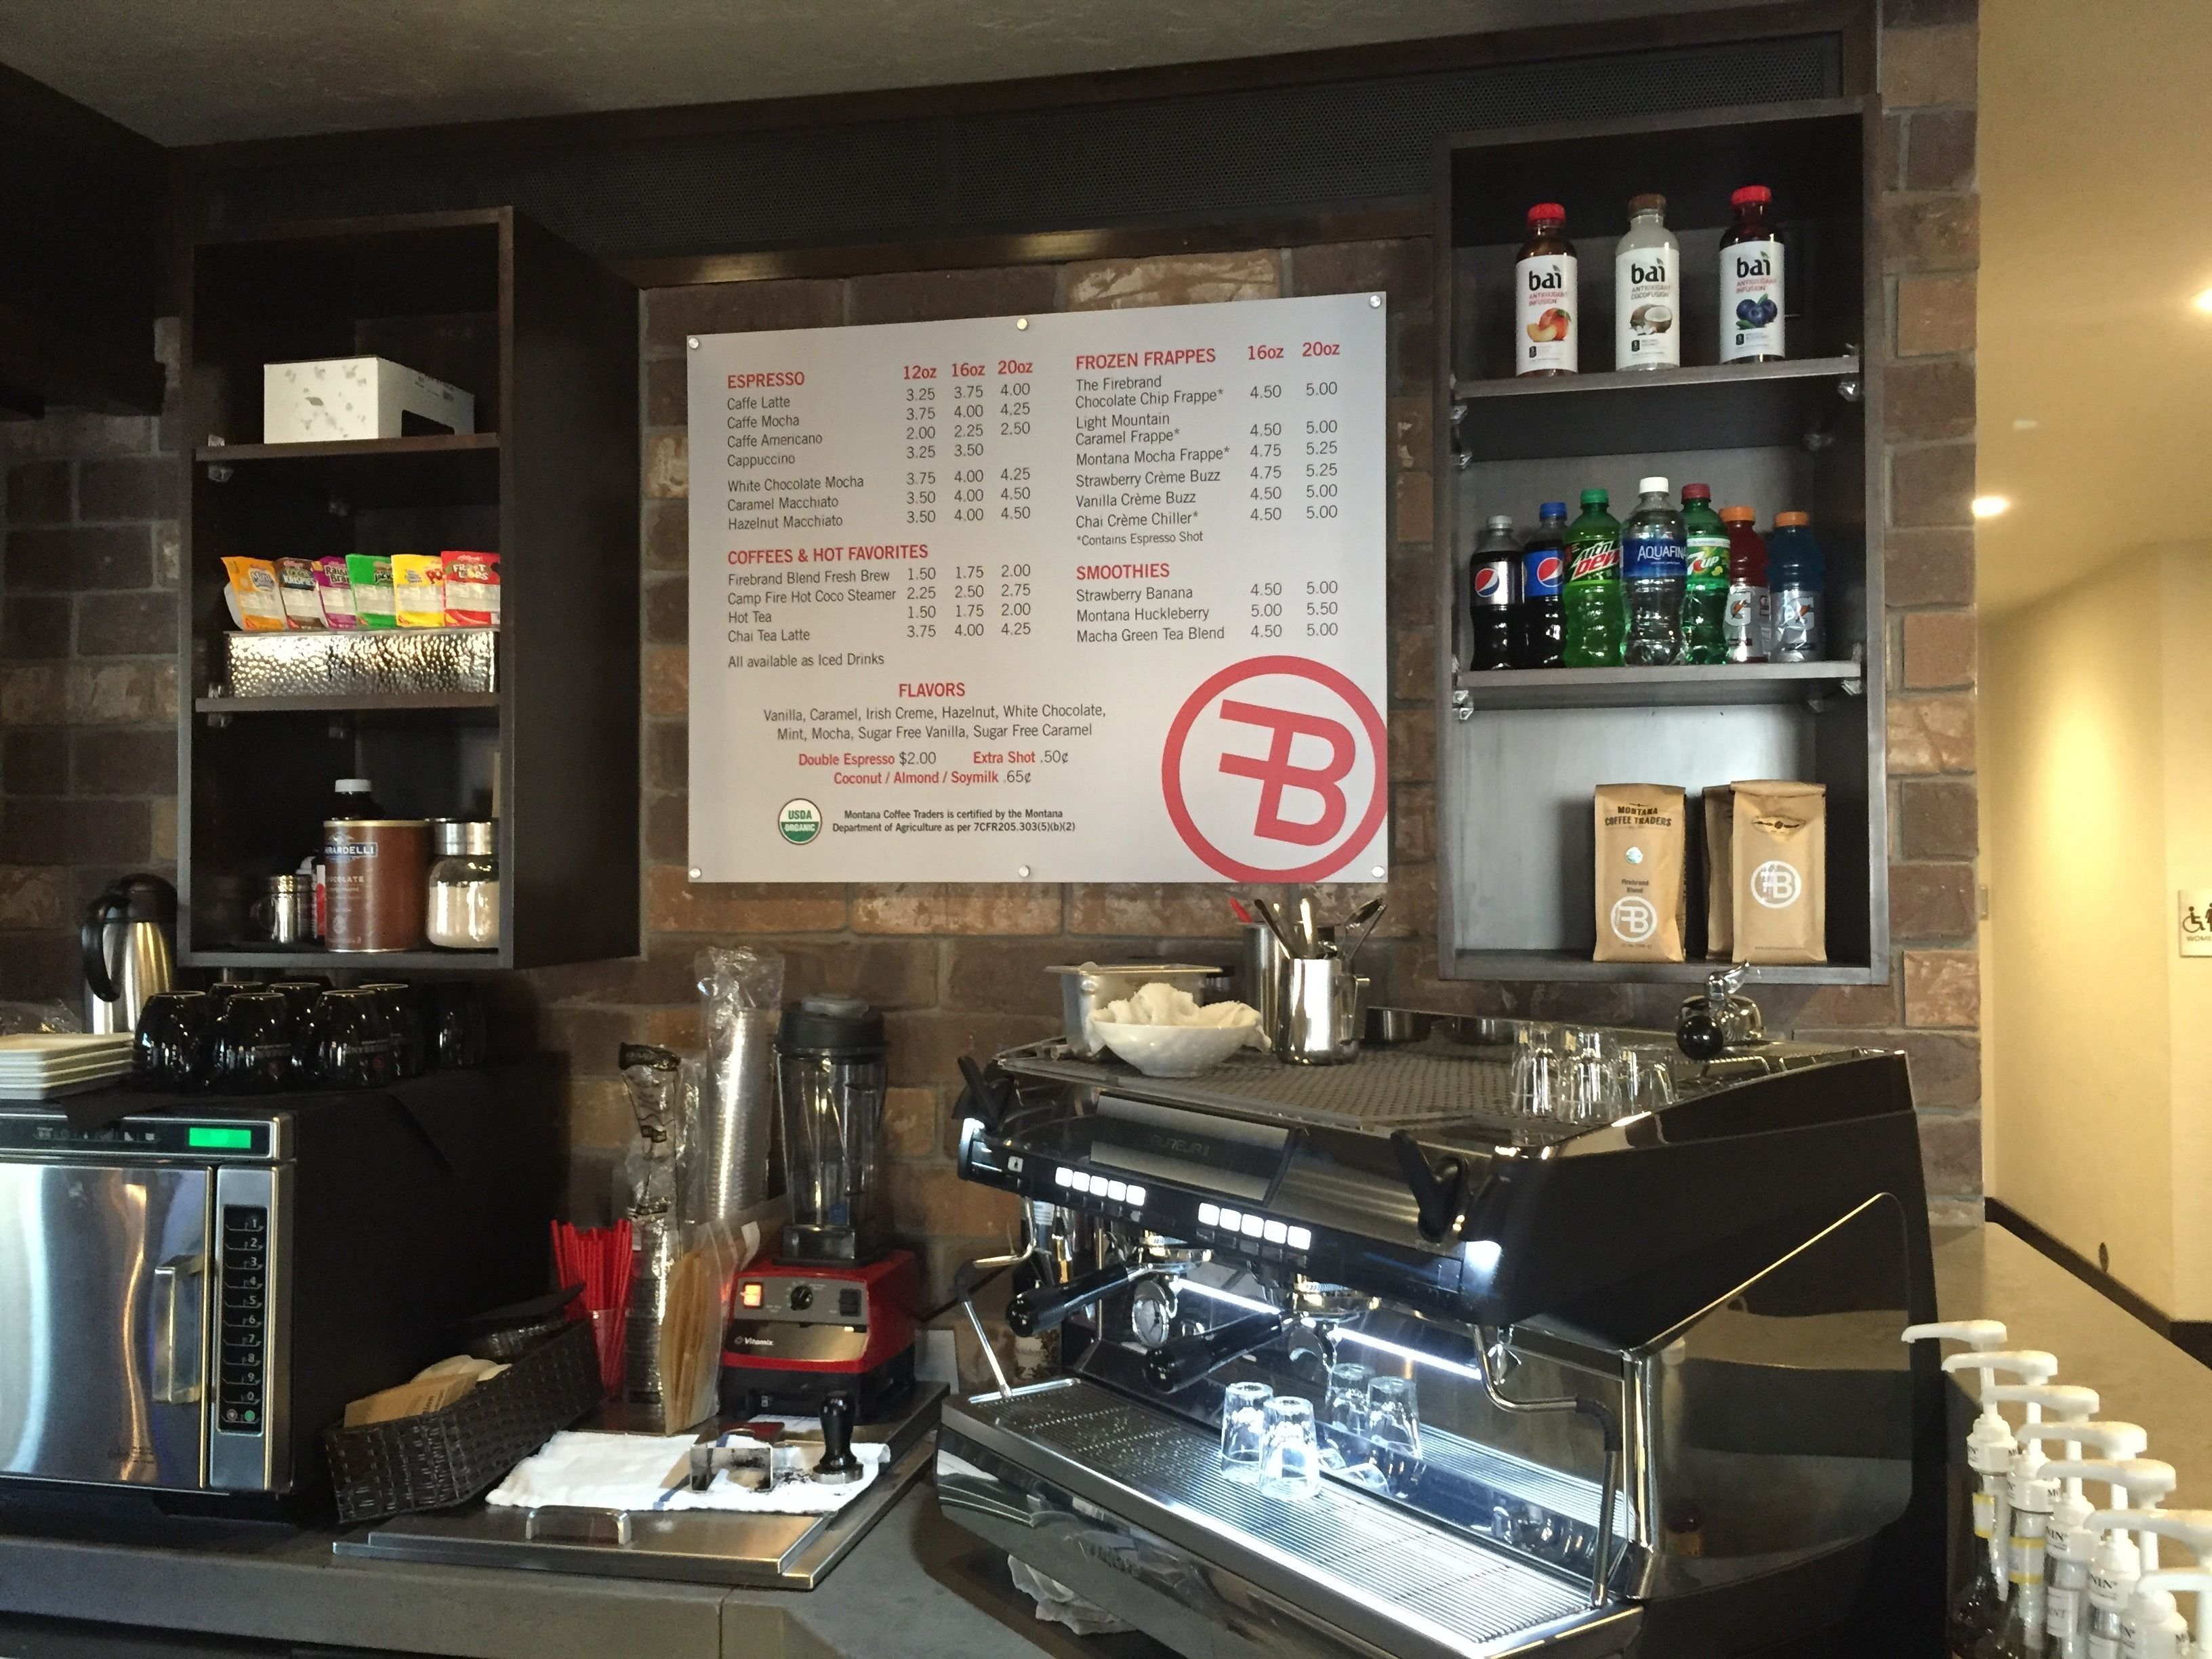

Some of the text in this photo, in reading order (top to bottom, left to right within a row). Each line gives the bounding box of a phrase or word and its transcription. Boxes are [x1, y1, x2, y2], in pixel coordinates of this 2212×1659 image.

[1631, 260, 1665, 285] bai
[1736, 253, 1771, 279] bai
[1528, 266, 1561, 291] bai
[1076, 342, 1340, 370] FROZEN FRAPPES 16oz 20oz
[728, 360, 1033, 389] ESPRESSO 12oz 16oz 20oz
[1076, 375, 1161, 391] The Firebrand
[727, 383, 1030, 410] Caffe Latte 3.25 3.75 4.00
[1076, 394, 1136, 408] Chocolate
[1141, 392, 1169, 407] Chip
[1250, 385, 1282, 398] 4.50
[1307, 382, 1337, 396] 5.00
[1077, 413, 1169, 431] Light Mountain
[728, 434, 823, 448] Caffe Americano
[1076, 431, 1125, 445] Caramel
[727, 455, 795, 468] Cappuccino
[1077, 453, 1129, 466] Montana
[1134, 450, 1175, 463] Mocha
[728, 476, 863, 492] White Chocolate Mocha
[728, 496, 838, 511] Caramel Macchiato
[1130, 533, 1176, 546] Espresso
[1179, 531, 1203, 542] Shot
[728, 544, 928, 565] COFFEES & HOT FAVORITES
[325, 565, 348, 577] Raisi
[374, 573, 393, 583] JACK
[729, 564, 1030, 586] Firebrand Blend Fresh Brew 1.50 1.75 2.00
[1077, 563, 1170, 580] SMOOTHIES
[1077, 581, 1338, 602] Strawberry Banana 4.50 5.00
[729, 611, 771, 623] Hot Tea
[1078, 626, 1224, 642] Macha Green Tea Blend
[728, 653, 884, 668] All available as Iced Drinks
[899, 682, 965, 697] FLAVORS
[764, 703, 1105, 722] Vanilla, Caramel, Irish Creme, Hazelnut, White Chocolate,
[777, 723, 1092, 741] Mint, Mocha, Sugar Free Vanilla, Sugar Free Caramel
[799, 752, 936, 767] Double Espresso $2.00
[974, 750, 1068, 764] Extra Shot .50¢
[834, 773, 882, 784] Coconut
[894, 771, 939, 783] Almond
[951, 771, 999, 785] Soymilk
[1004, 770, 1031, 783] .65¢
[789, 811, 812, 819] USDA
[844, 808, 1063, 820] Montana Coffee Traders is certified by the Montana
[1618, 806, 1658, 815] MONTANA
[784, 823, 816, 832] ORGANIC
[832, 823, 882, 834] Department
[884, 823, 893, 832] of
[895, 823, 942, 834] Agriculture
[957, 825, 970, 834] per
[974, 822, 1075, 832] 7CFR205.303(5)(b)(2)
[1605, 816, 1673, 826] COFFEE TRADERS
[252, 1219, 257, 1228] 1
[250, 1238, 257, 1248] 2
[250, 1257, 257, 1267] 3
[250, 1276, 255, 1286] 4
[249, 1296, 256, 1305] 5
[249, 1315, 255, 1324] 6
[249, 1334, 255, 1343] 7
[744, 1337, 774, 1346] Vitamix
[248, 1353, 255, 1363] 8
[247, 1372, 254, 1382] 9
[247, 1391, 255, 1401] 0
